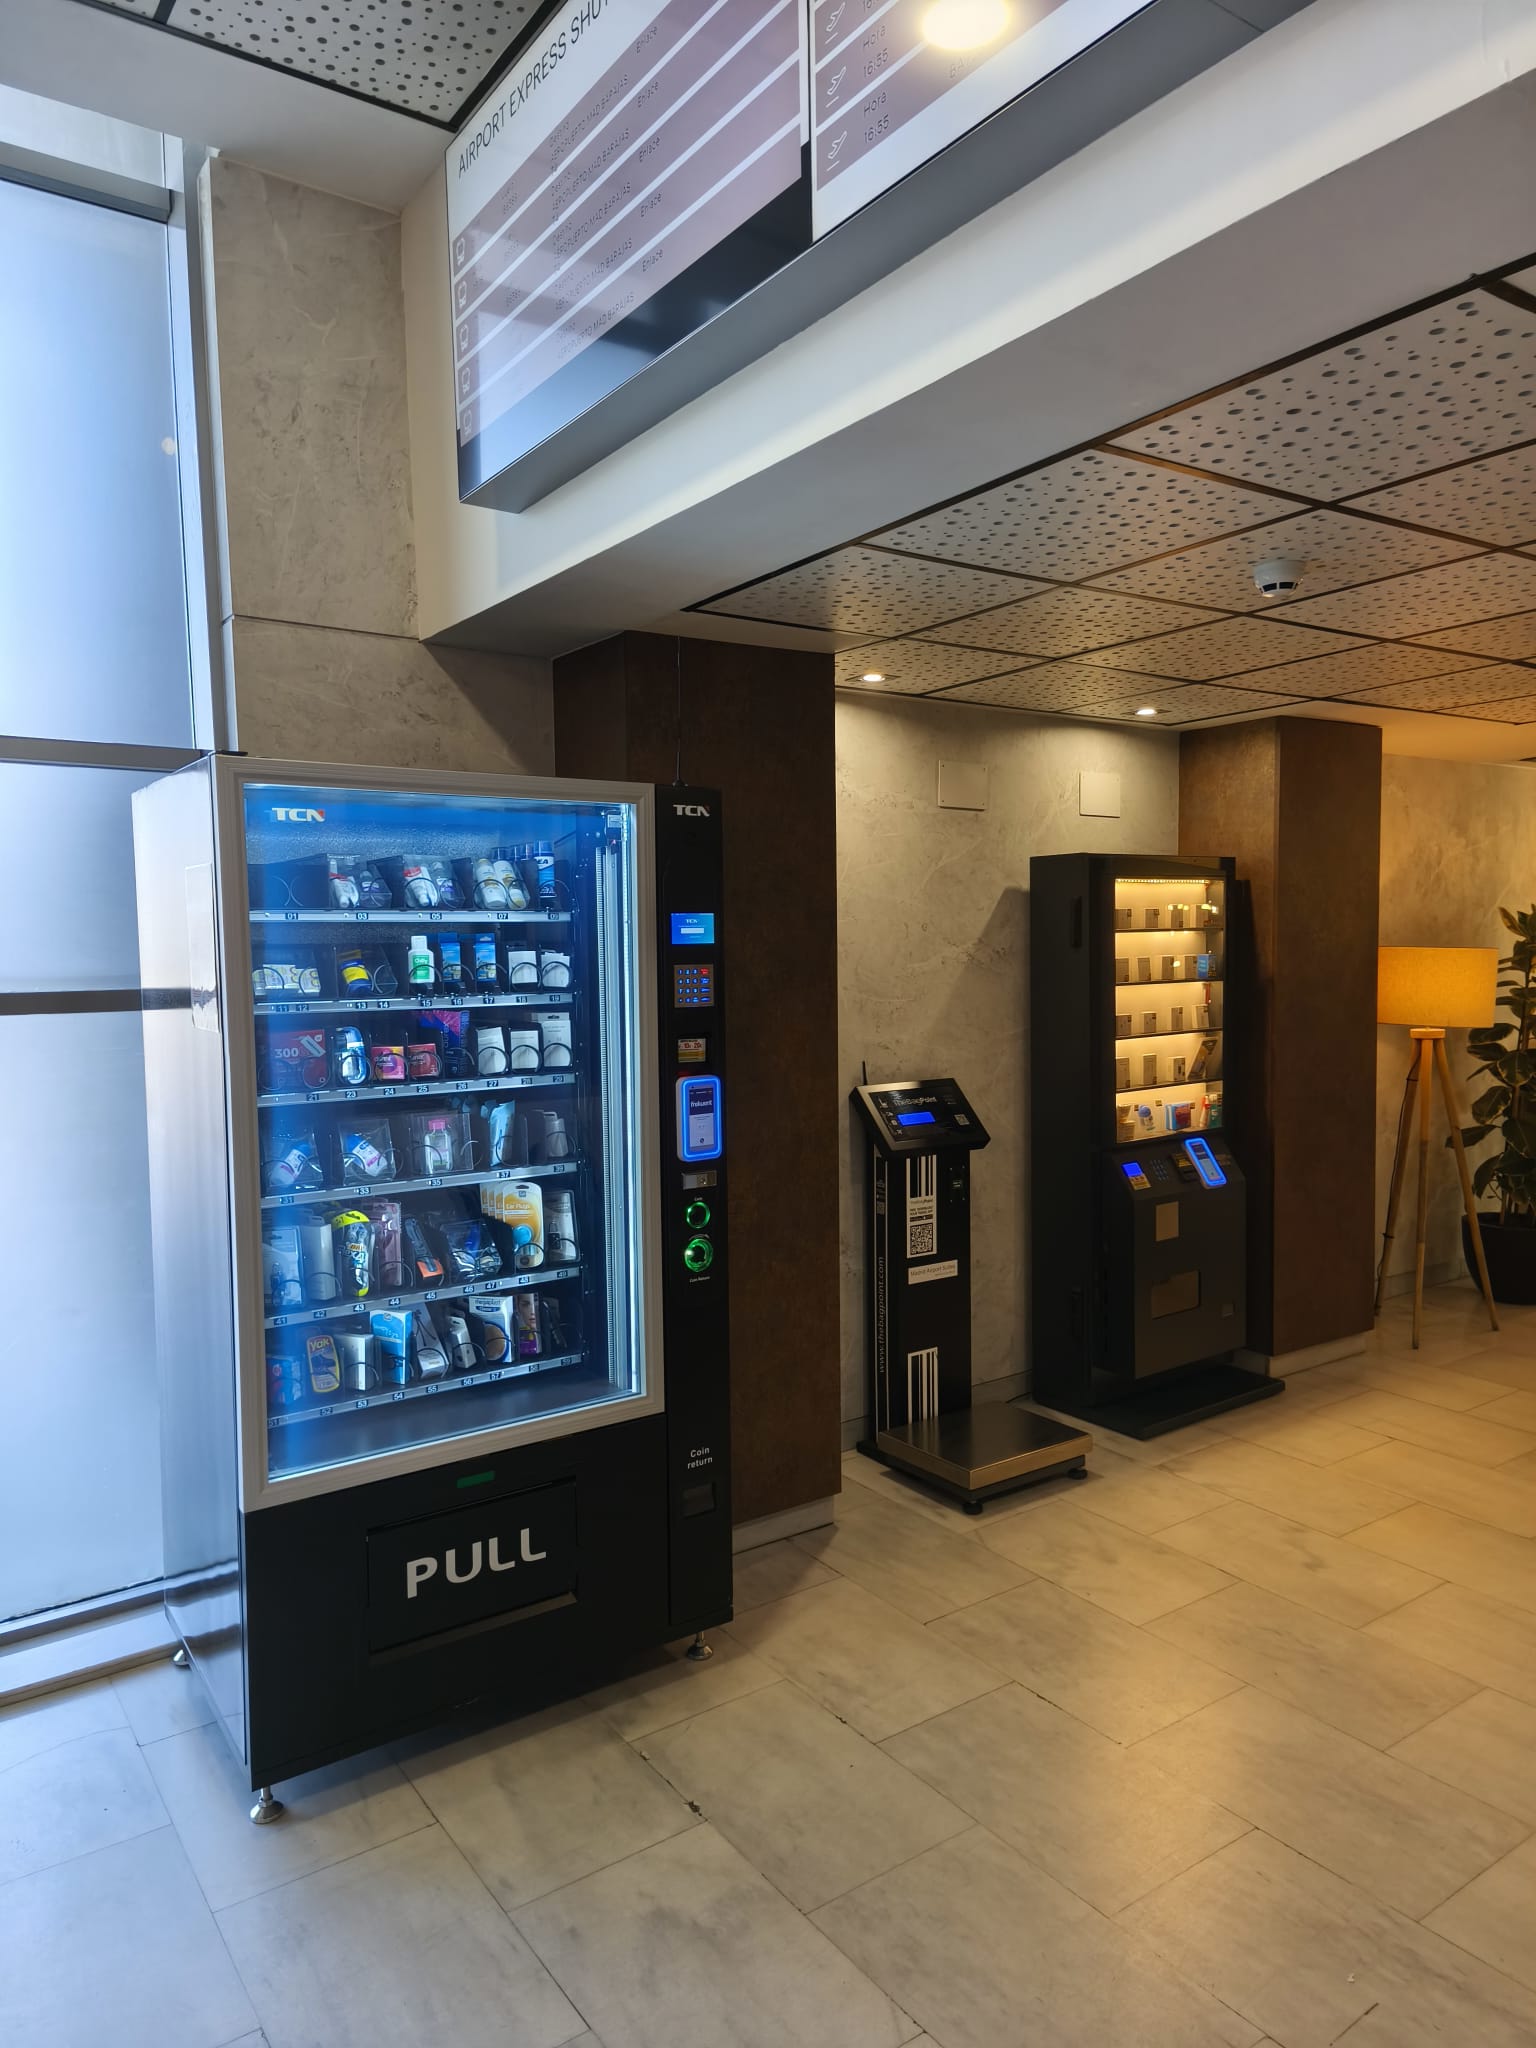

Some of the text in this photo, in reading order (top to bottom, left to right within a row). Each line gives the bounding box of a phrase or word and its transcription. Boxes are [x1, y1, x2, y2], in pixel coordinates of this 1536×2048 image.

[862, 24, 886, 48] Hora
[863, 50, 889, 78] 16:55
[459, 102, 506, 179] AIRPORT
[510, 32, 567, 118] EXPRESS
[863, 91, 888, 116] Hora
[864, 114, 890, 143] 16:55
[272, 807, 325, 822] TCN
[673, 804, 710, 817] TCN
[274, 1047, 299, 1059] 300
[687, 1455, 713, 1470] return
[690, 1446, 710, 1459] Coin
[406, 1527, 547, 1599] PULL
